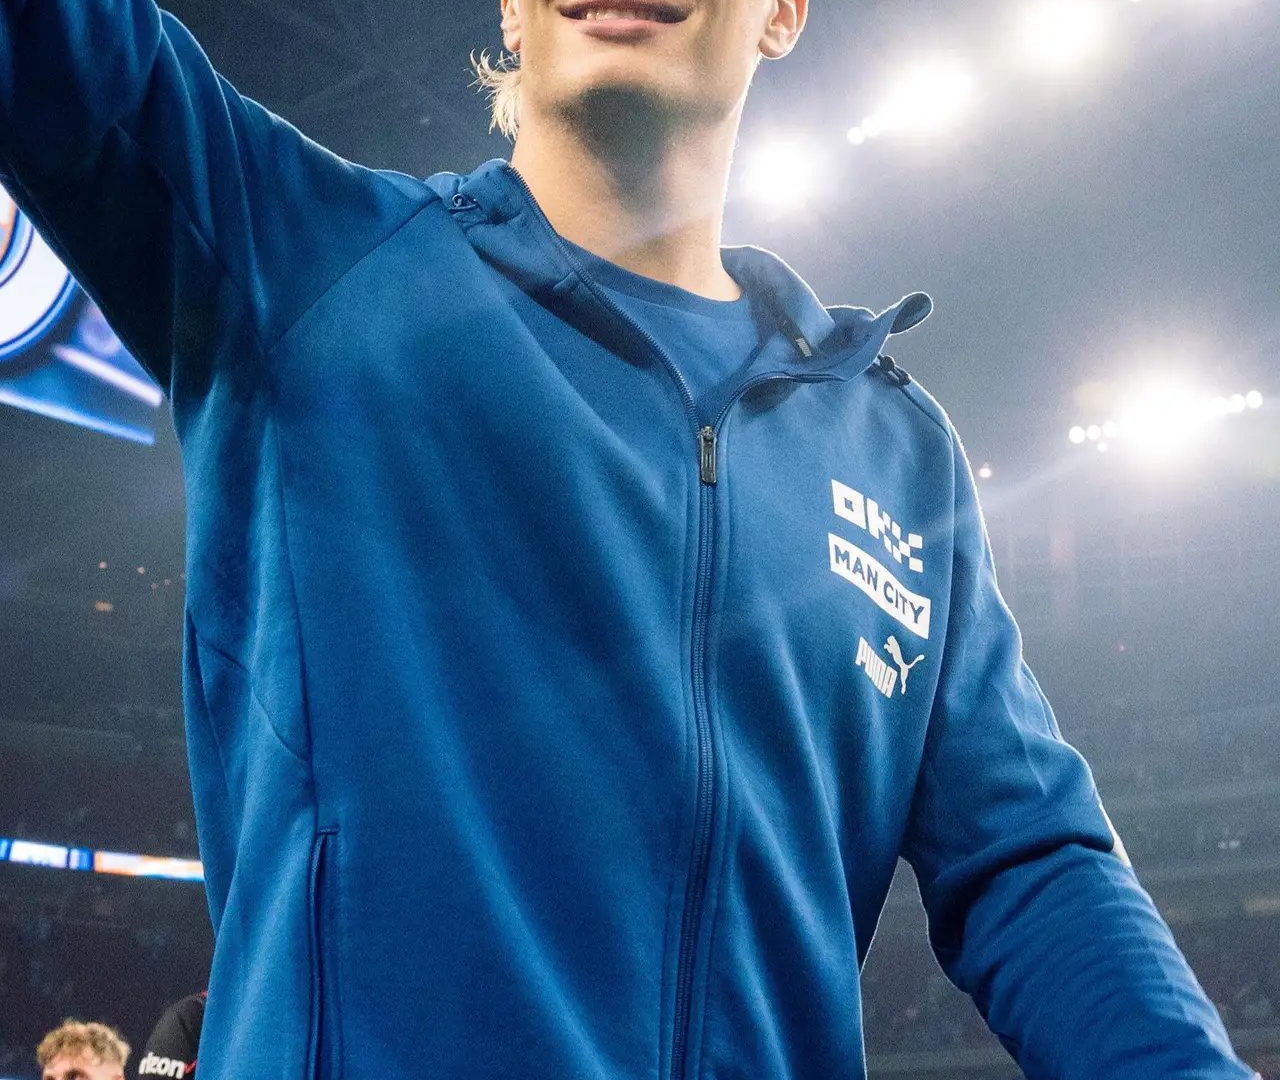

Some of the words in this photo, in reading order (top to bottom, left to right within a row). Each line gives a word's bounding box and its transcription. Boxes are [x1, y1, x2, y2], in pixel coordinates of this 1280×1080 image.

[830, 478, 924, 574] OKX
[833, 543, 879, 592] MAN
[883, 581, 926, 626] CITY
[855, 635, 899, 699] PUMA
